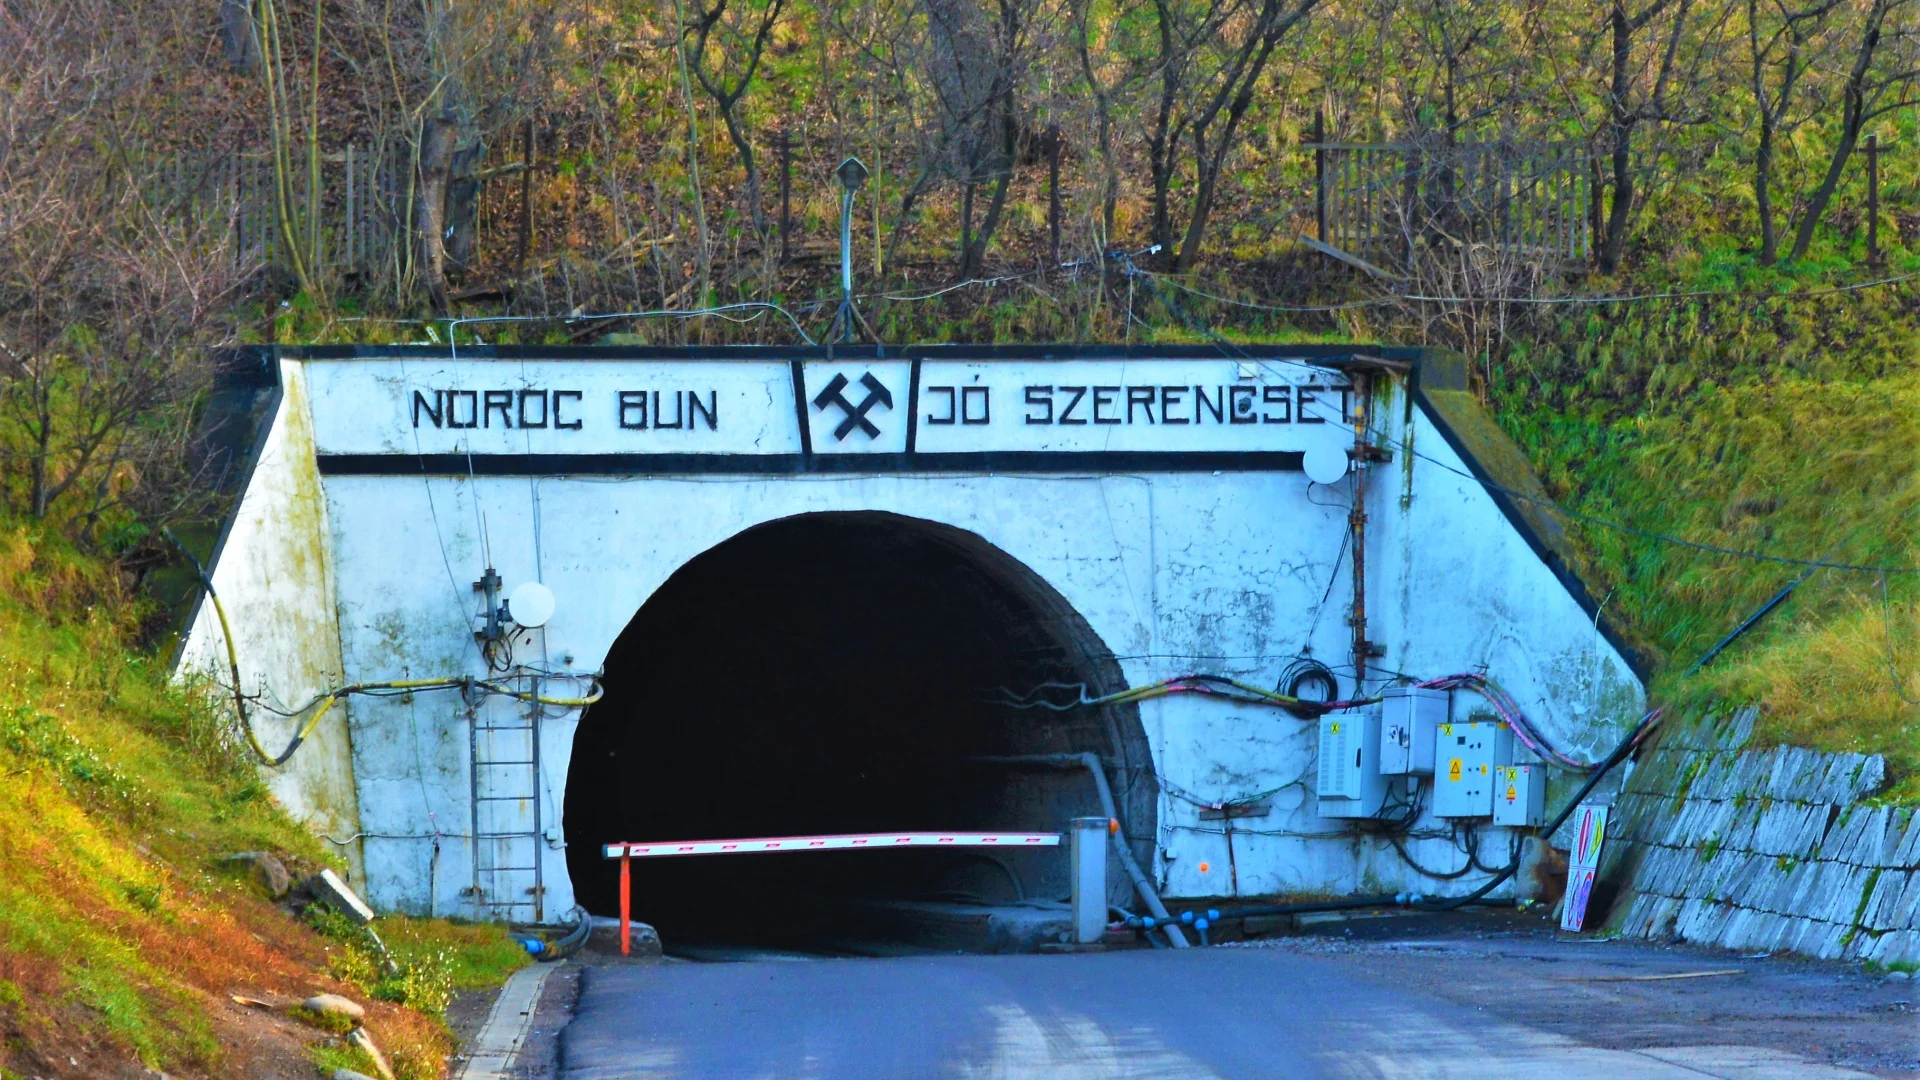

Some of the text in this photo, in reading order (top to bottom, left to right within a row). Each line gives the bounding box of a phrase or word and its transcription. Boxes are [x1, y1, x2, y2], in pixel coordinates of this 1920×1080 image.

[413, 389, 717, 431] NOROC BUN
[927, 373, 1354, 424] JÓ SZERENCSÉT
